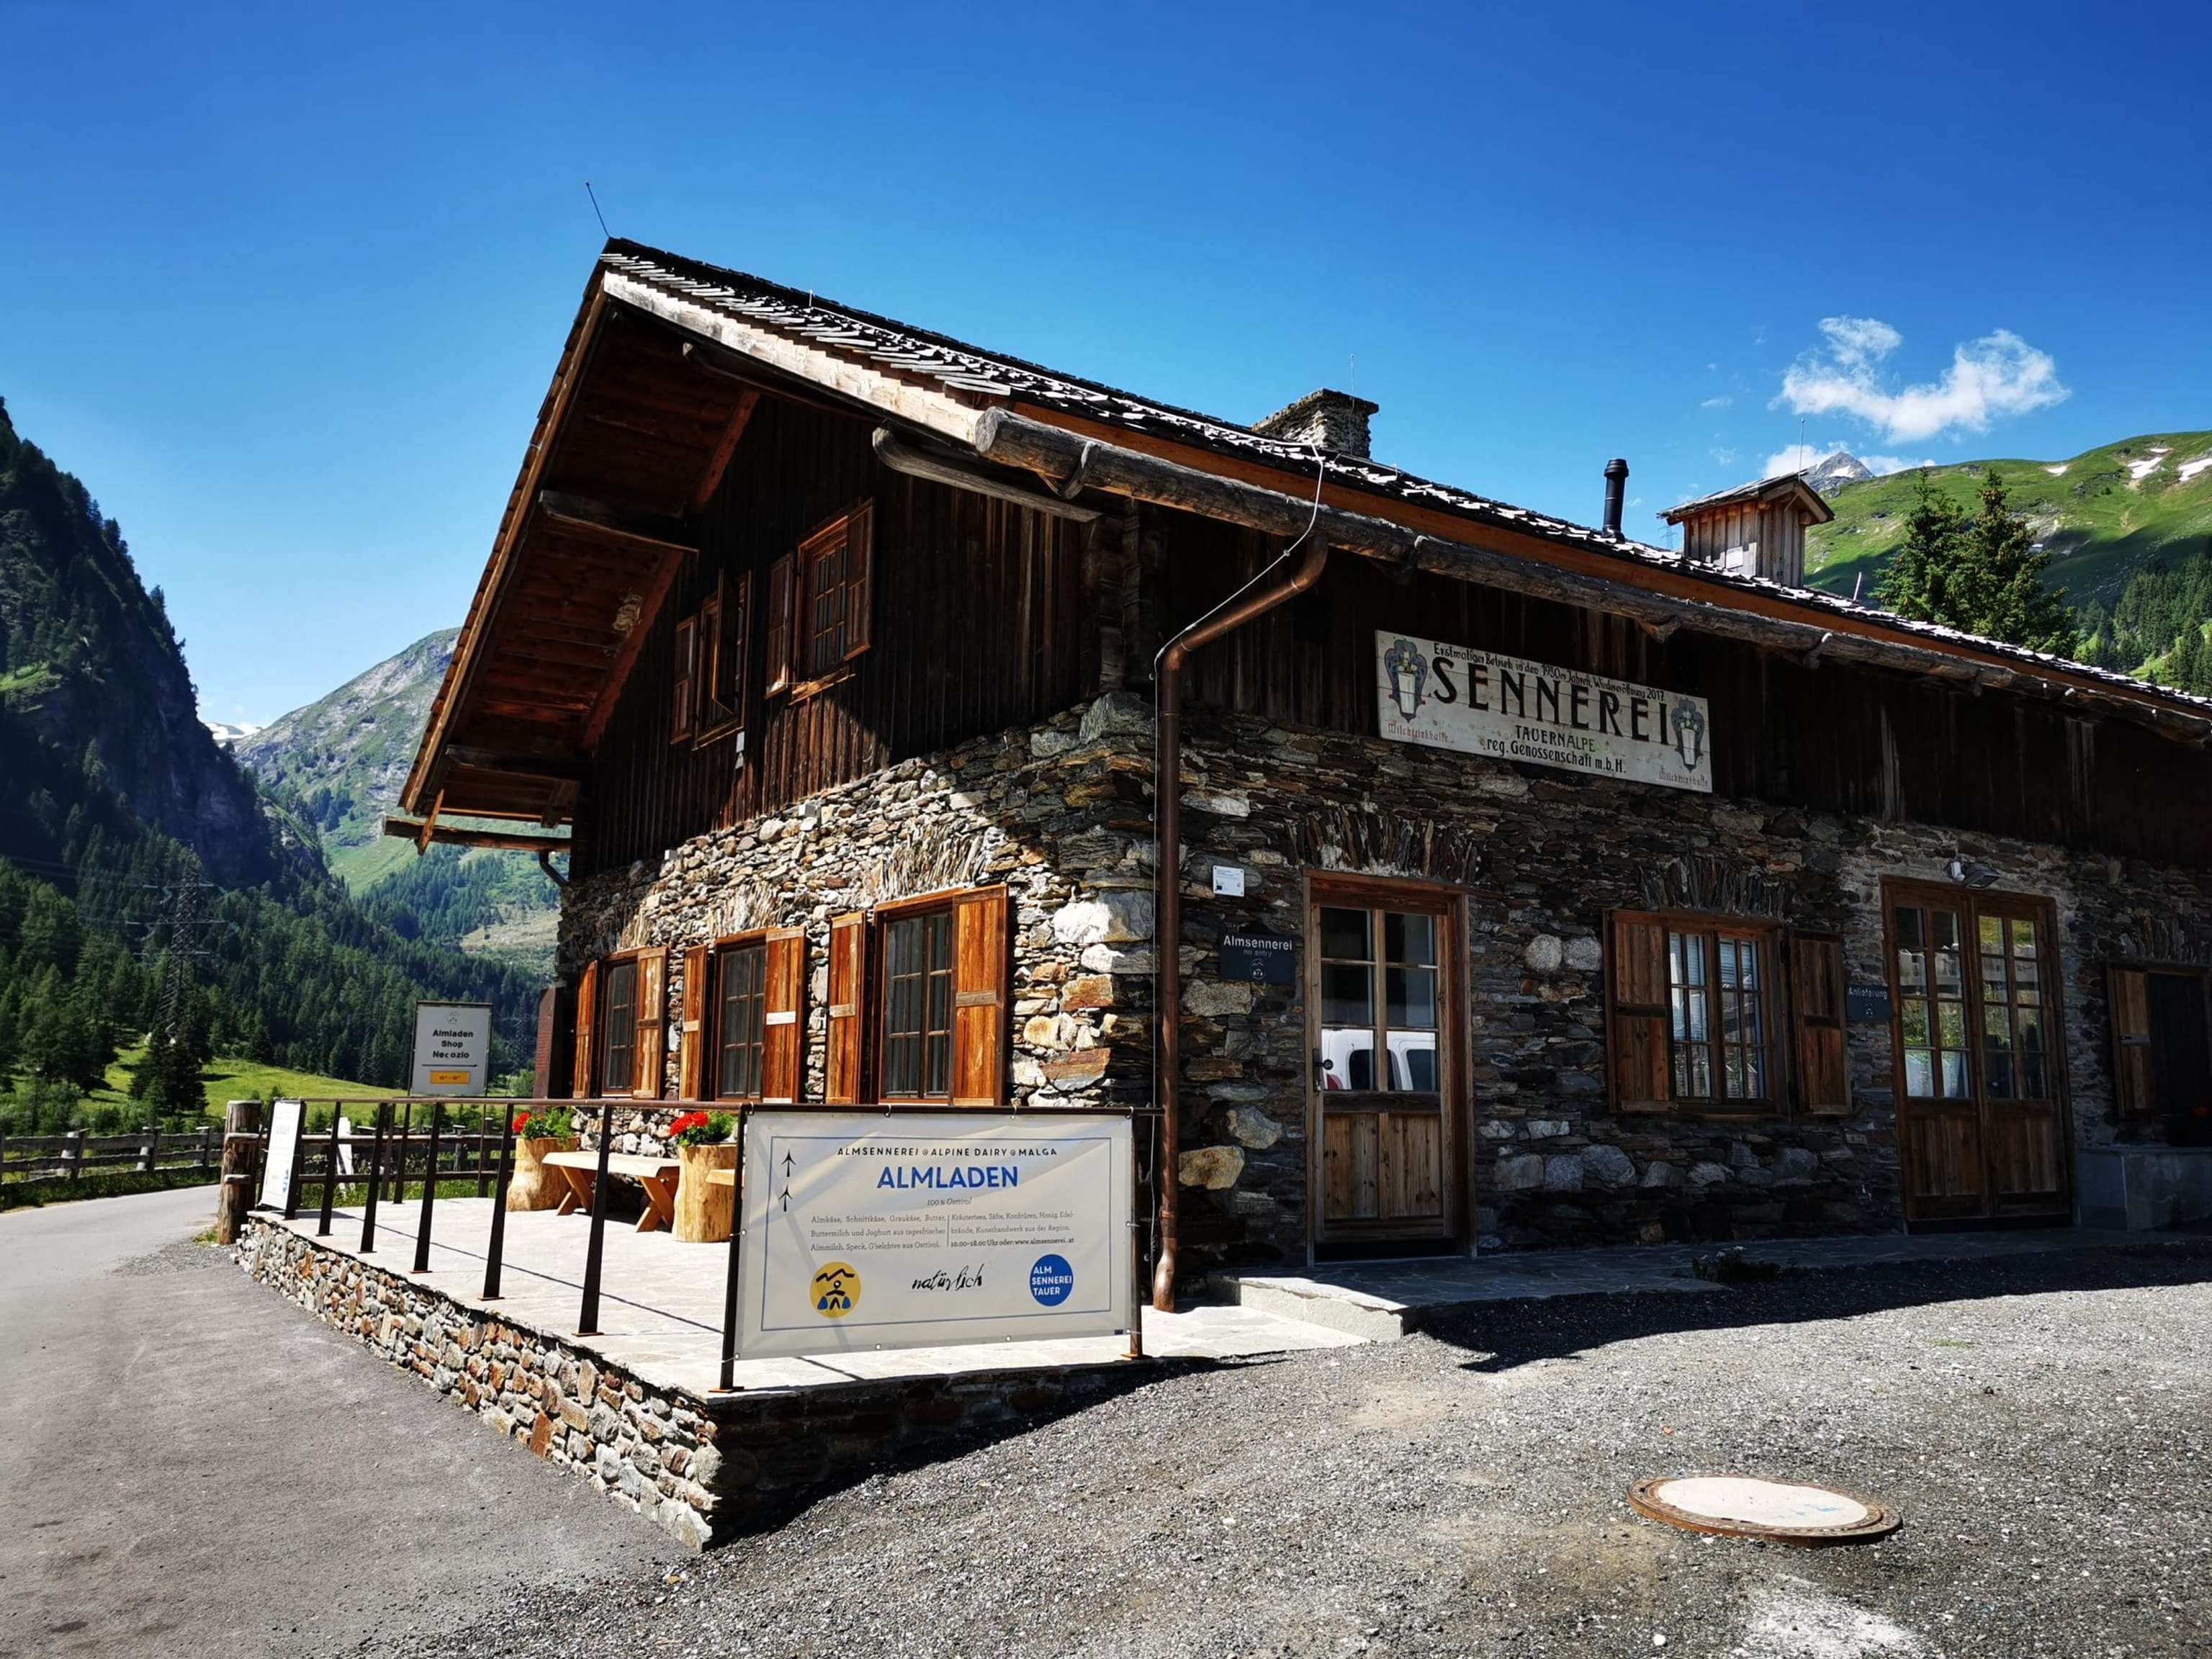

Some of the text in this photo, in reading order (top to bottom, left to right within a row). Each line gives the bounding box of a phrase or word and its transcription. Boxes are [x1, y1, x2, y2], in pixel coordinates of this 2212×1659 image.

[1526, 662, 1539, 674] den
[1646, 688, 1665, 701] 2017
[1432, 656, 1668, 745] SENNEREI
[1515, 724, 1596, 752] TAUERNALPE
[1487, 739, 1509, 757] reg.
[1511, 741, 1592, 765] Genossenschaft
[1223, 935, 1292, 950] Almsennerei
[1848, 986, 1887, 1000] Anlieferung
[432, 1029, 474, 1038] Almladen
[441, 1040, 464, 1048] Shop
[837, 1147, 919, 1156] ALMSENNEREI
[930, 1148, 969, 1156] ALPINE
[876, 1166, 1018, 1189] ALMLADEN
[889, 1214, 922, 1223] Graukäse,
[811, 1228, 850, 1238] Buttermilch
[851, 1228, 864, 1237] und
[866, 1228, 891, 1238] Joghurt
[905, 1226, 946, 1236] tagesfrischer
[950, 1226, 975, 1235] brände,
[976, 1225, 1023, 1233] Kunsthandwerk
[1048, 1224, 1071, 1233] Region.
[1034, 1266, 1053, 1274] ALM
[912, 1263, 985, 1292] natürlich
[1031, 1276, 1072, 1286] SENNEREI
[1033, 1286, 1061, 1297] TAUER
